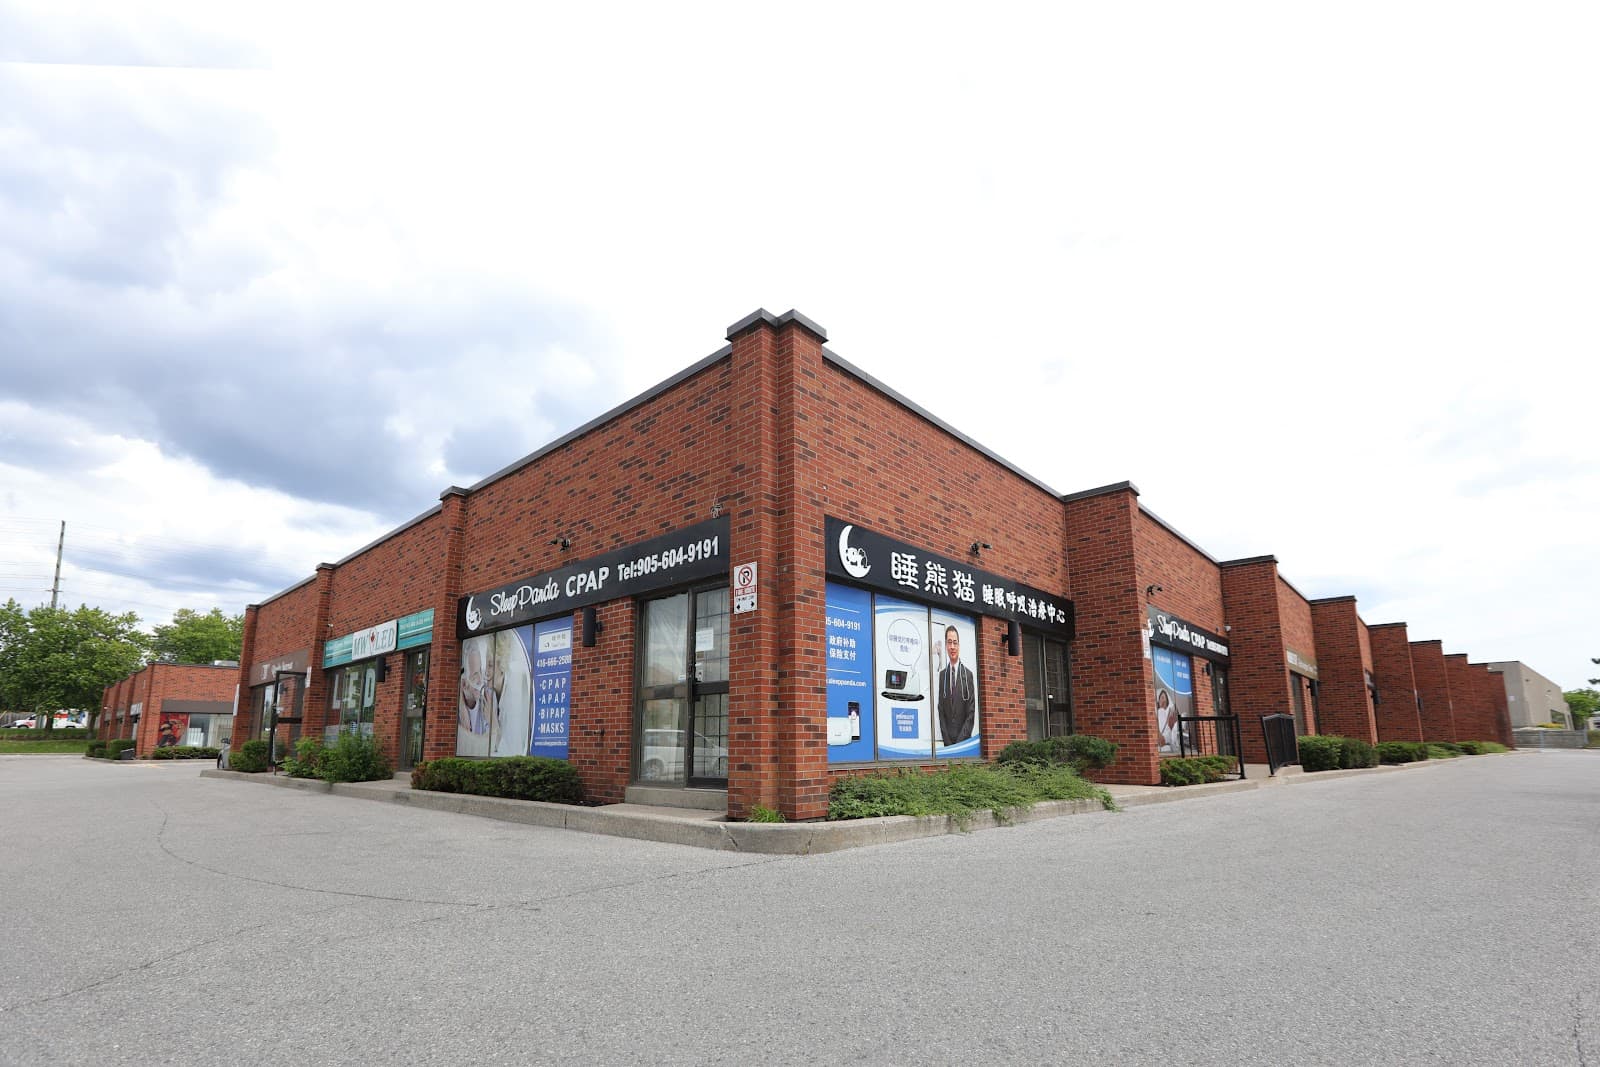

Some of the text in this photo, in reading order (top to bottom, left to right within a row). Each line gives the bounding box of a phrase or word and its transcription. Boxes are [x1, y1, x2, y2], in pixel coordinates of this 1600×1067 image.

[565, 566, 610, 597] CPAP
[891, 551, 975, 602] 睡熊猫
[375, 627, 396, 650] LED
[541, 677, 567, 690] CPAP
[541, 692, 566, 705] APAP
[540, 722, 565, 734] MASKS
